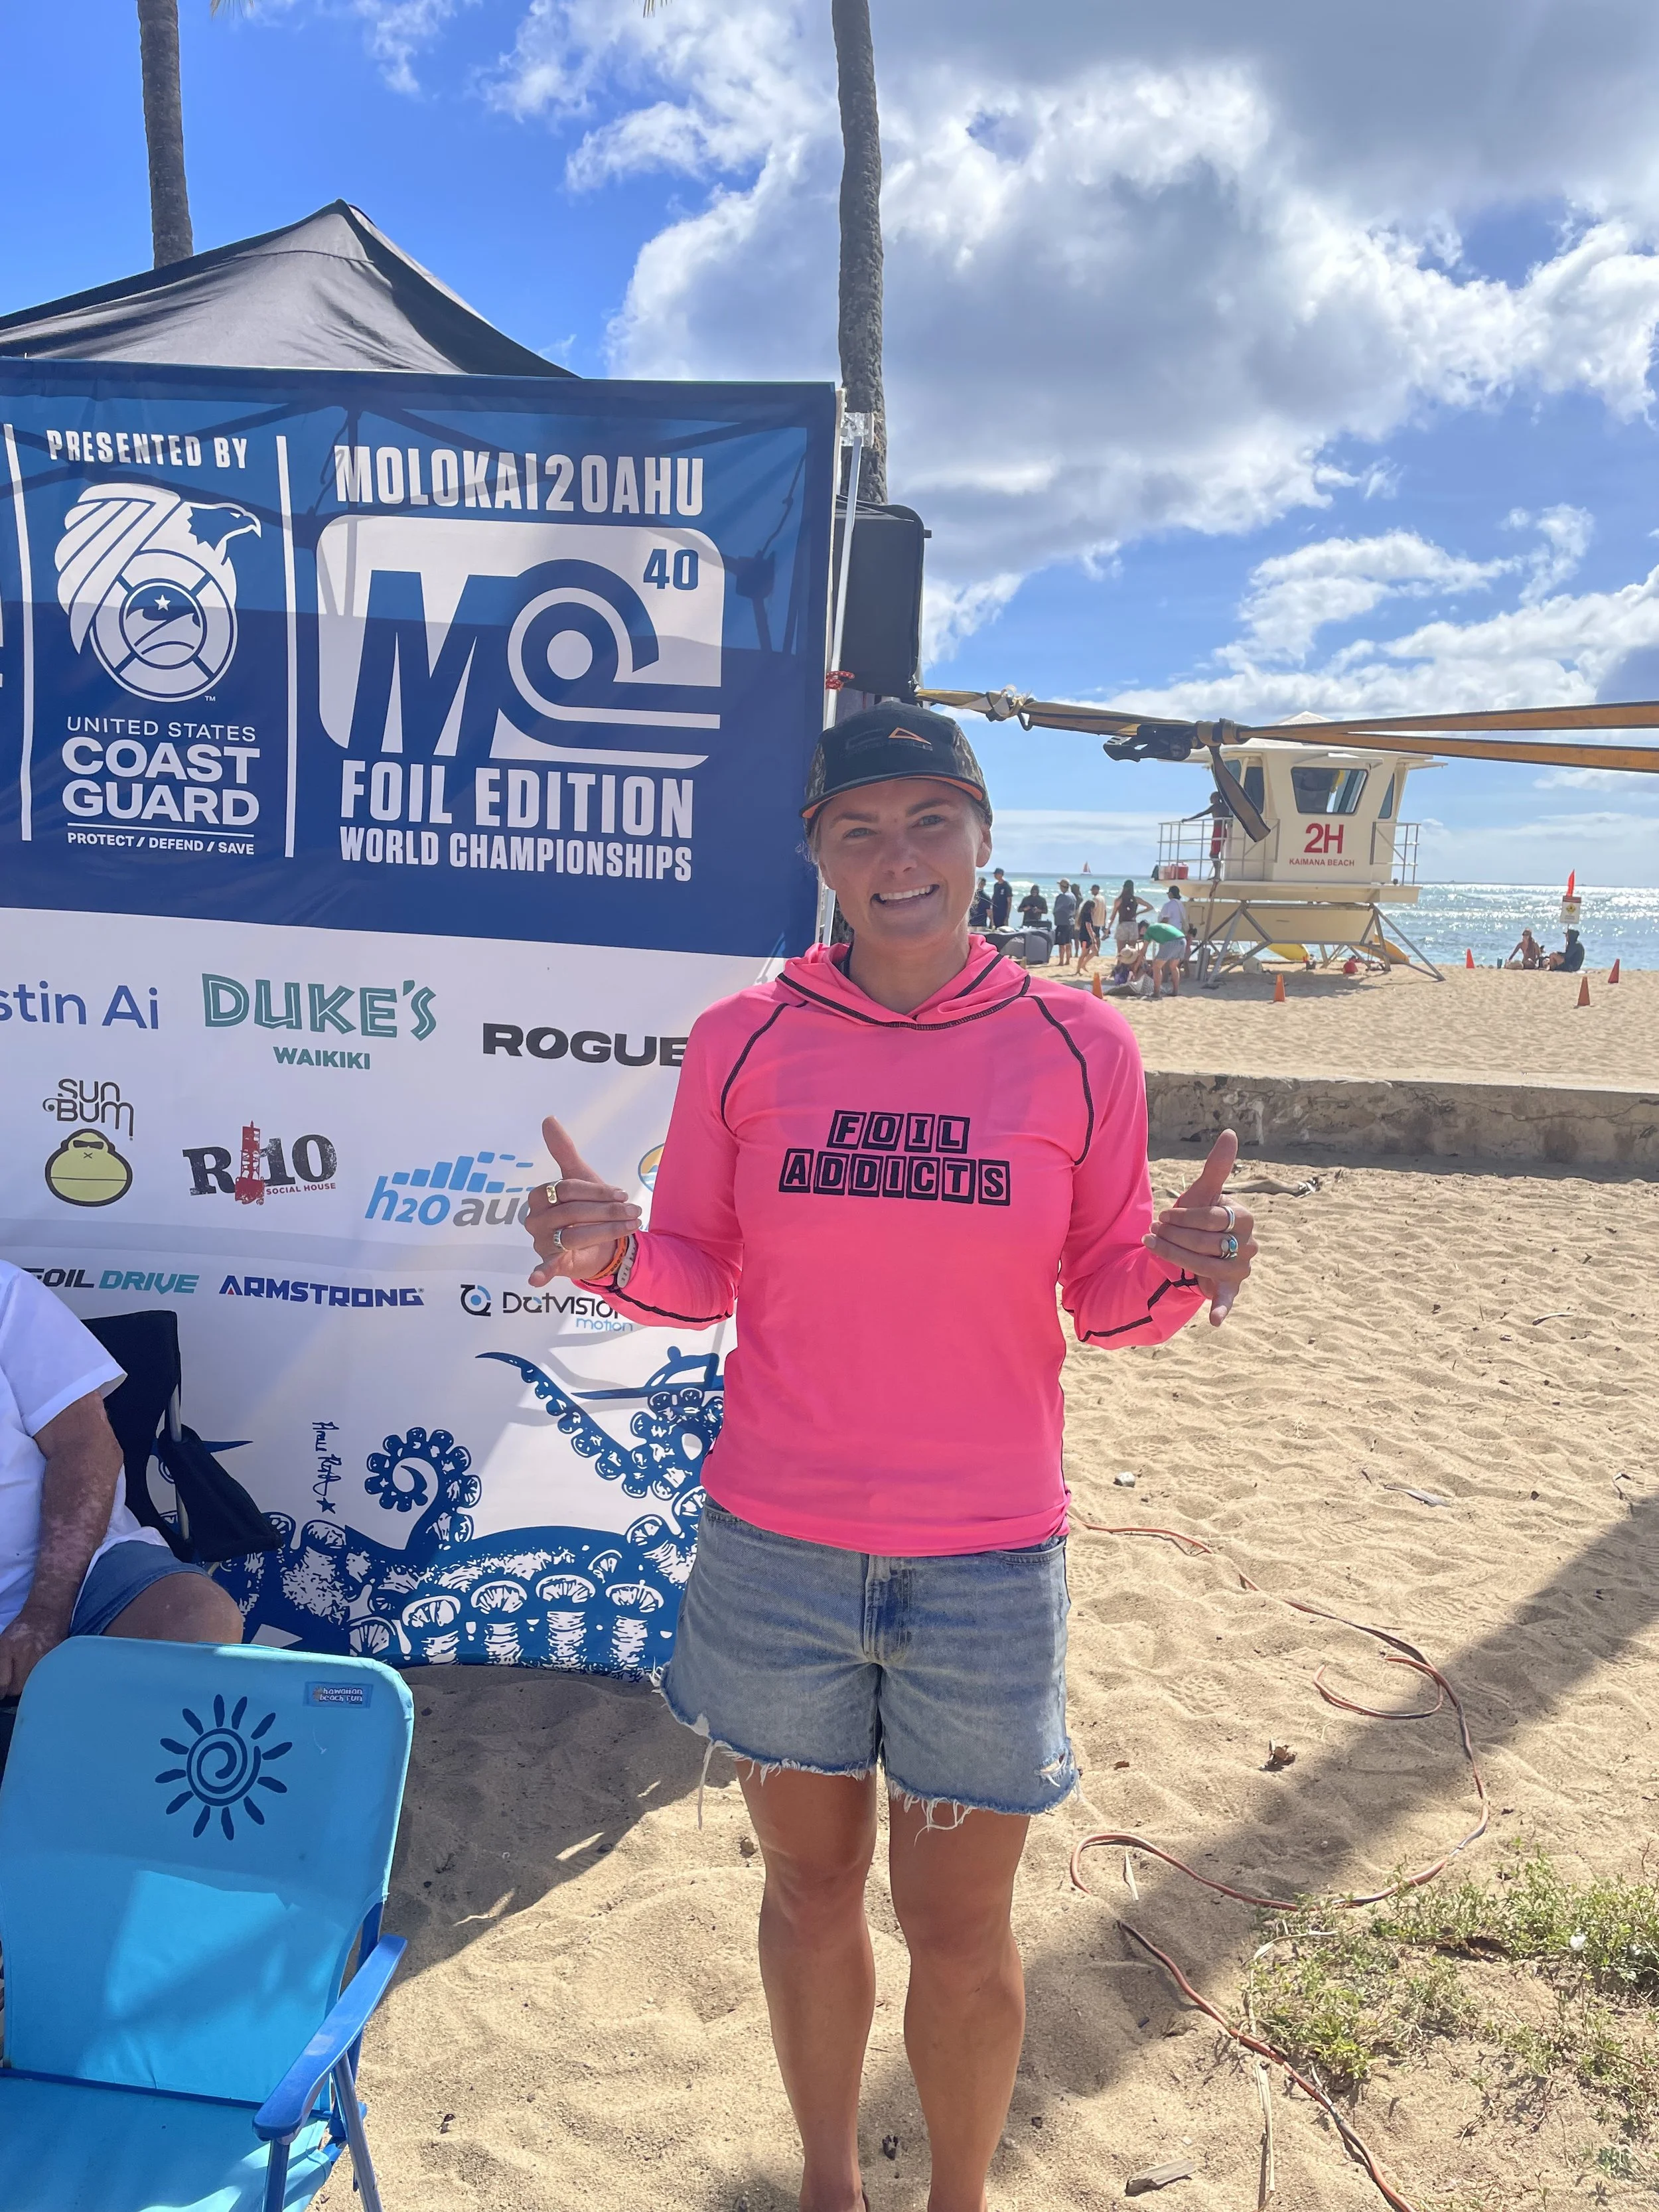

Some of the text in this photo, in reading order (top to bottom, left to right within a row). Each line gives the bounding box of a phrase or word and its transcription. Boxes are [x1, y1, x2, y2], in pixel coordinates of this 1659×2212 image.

[46, 430, 247, 469] PRESENTED BY
[643, 548, 699, 591] 40
[67, 716, 255, 741] UNITED STATES
[62, 736, 260, 784] COAST
[62, 779, 259, 826] GUARD
[340, 760, 694, 839] FOIL EDITION
[68, 833, 134, 848] PROTECT
[149, 838, 204, 851] DEFEND
[218, 842, 254, 855] SAVE
[339, 826, 692, 882] WORLD CHAMPIONSHIPS
[1304, 823, 1344, 853] 2H
[102, 984, 159, 1029] Ai
[202, 973, 437, 1041] DUKE'S
[273, 1046, 371, 1070] WAIKIKI
[482, 1023, 688, 1067] ROGUE
[826, 1110, 970, 1154] FOIL
[266, 1183, 336, 1195] SOCIAL HOUSE
[778, 1148, 1011, 1207] ADDICTS
[99, 1270, 200, 1295] DRIVE
[576, 1317, 633, 1331] motion
